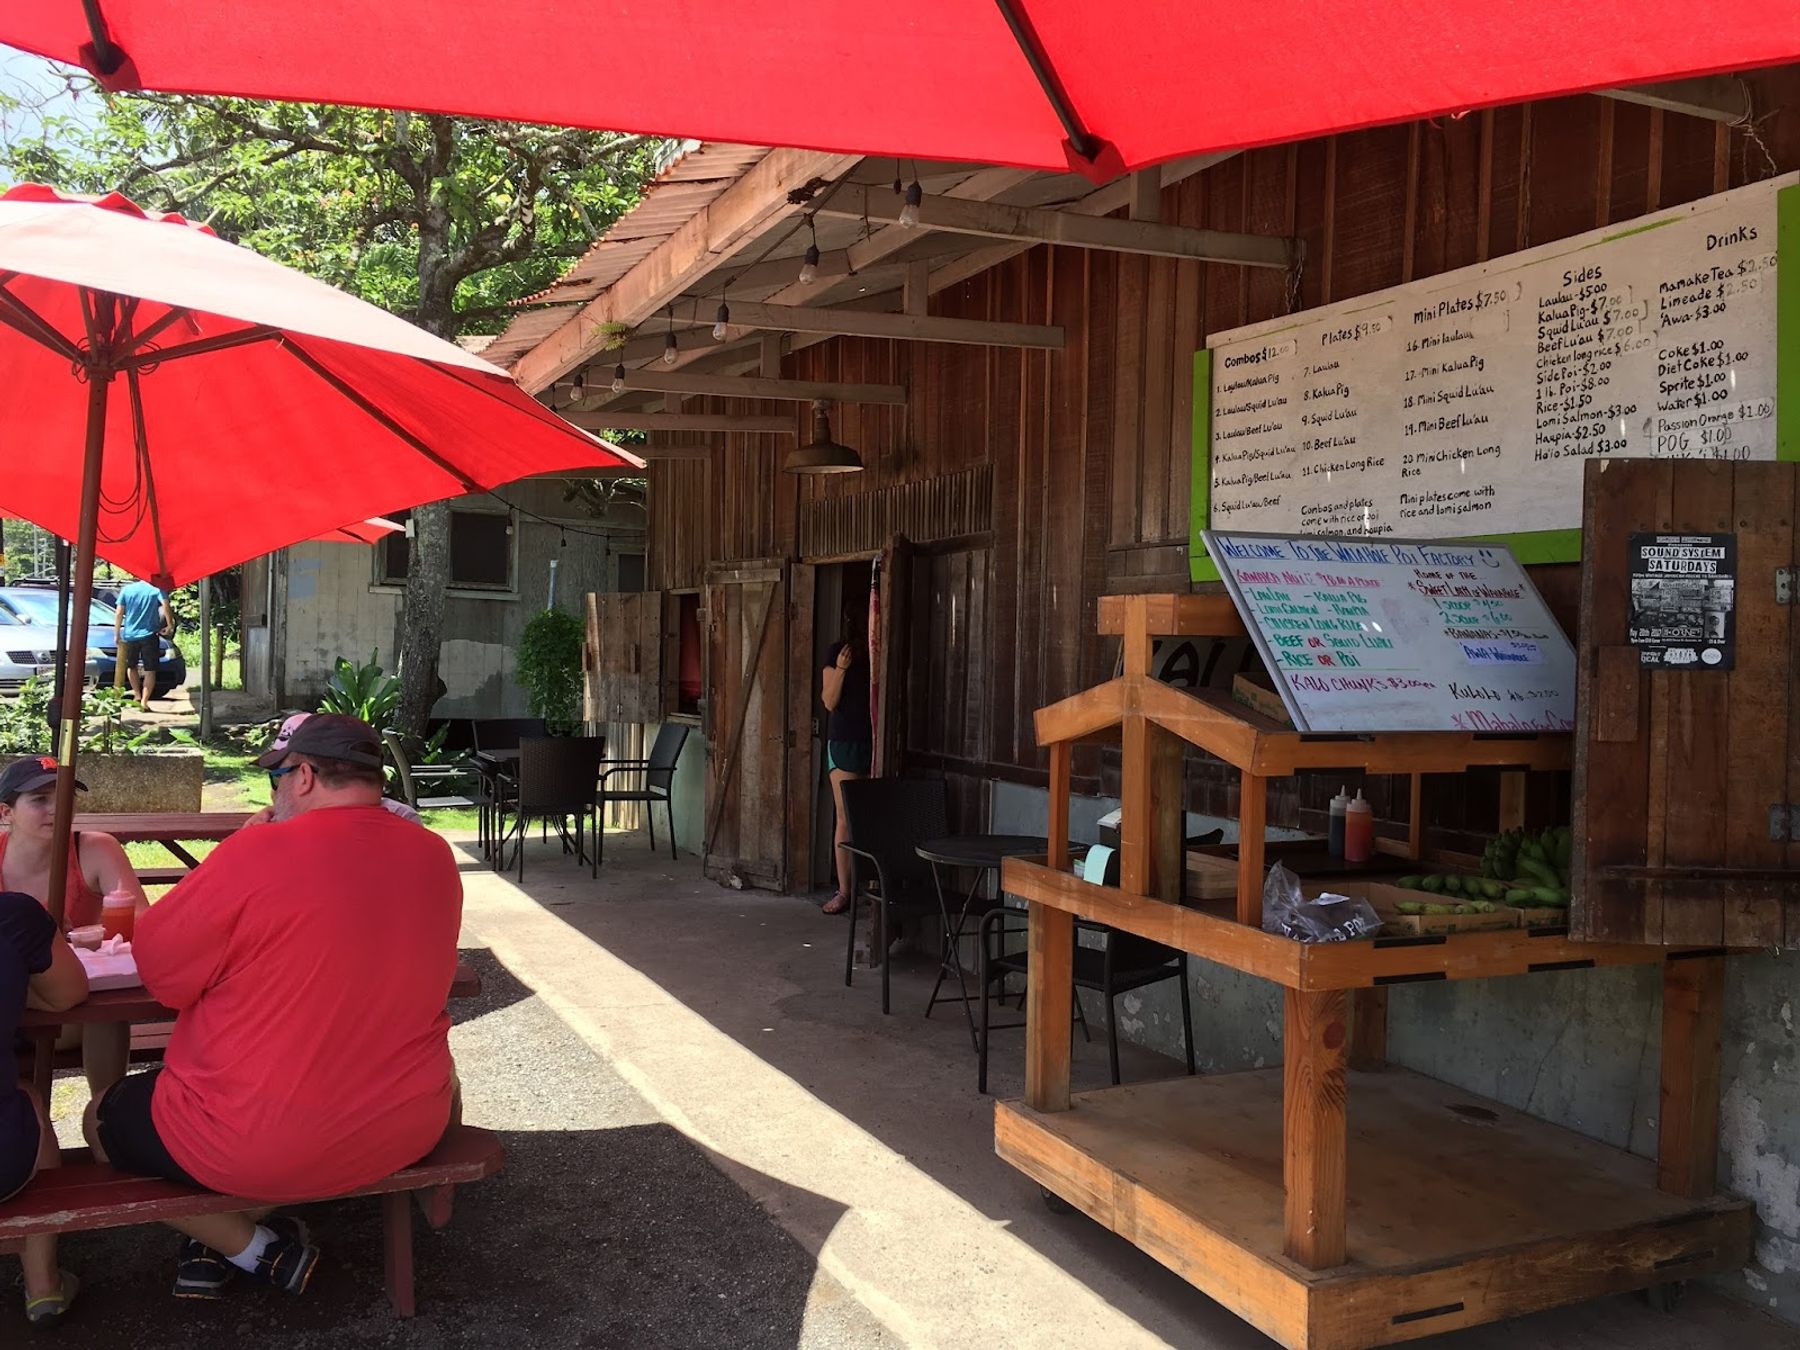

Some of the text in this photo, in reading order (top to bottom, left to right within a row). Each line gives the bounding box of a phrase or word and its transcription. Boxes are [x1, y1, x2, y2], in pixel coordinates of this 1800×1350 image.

[1563, 266, 1602, 287] Sides
[1711, 266, 1734, 281] Tea
[1438, 298, 1473, 317] Plates
[1475, 290, 1506, 311] $7.50
[1661, 288, 1712, 310] Limeade
[1538, 309, 1570, 324] Kalua
[1538, 320, 1569, 341] Squid
[1603, 308, 1639, 326] $7.00
[1322, 329, 1352, 346] Plates
[1421, 335, 1440, 349] Mini
[1538, 338, 1563, 354] Beef
[1692, 339, 1724, 356] $1.00
[1225, 352, 1260, 368] Combos
[1537, 353, 1571, 369] Chicken
[1573, 350, 1592, 362] long
[1594, 346, 1613, 356] rice
[1658, 360, 1681, 377] Diet
[1716, 351, 1749, 368] $1.00
[1421, 367, 1439, 378] Mini
[1442, 361, 1469, 373] Kalua
[1470, 355, 1485, 372] Pig
[1537, 369, 1560, 385] Side
[1660, 372, 1726, 396] Sprite $1.00
[1313, 386, 1335, 400] Kalua
[1337, 382, 1349, 398] Pig
[1417, 392, 1436, 406] Mini
[1437, 385, 1463, 404] Squid
[1657, 389, 1728, 411] Water $1.00
[1311, 410, 1332, 426] Squid
[1418, 420, 1437, 432] Mini
[1438, 414, 1461, 430] Beef
[1658, 403, 1770, 433] Passion Orange $1.00
[1314, 437, 1332, 450] Beef
[1563, 441, 1594, 457] Salad
[1597, 438, 1627, 453] $3.00
[1658, 428, 1732, 453] POG $1.00
[1222, 453, 1241, 462] Kalua
[1417, 445, 1501, 463] Mini Chicken Long
[1314, 463, 1344, 473] Chicken
[1345, 460, 1365, 472] Long
[1366, 456, 1385, 467] Rice
[1401, 468, 1421, 478] Rice
[1221, 477, 1241, 486] Kalua
[1400, 485, 1495, 506] Mini plates come with
[1222, 501, 1240, 514] Squid
[1301, 499, 1373, 515] Combos and plates
[1400, 501, 1492, 518] rice and lomi salmon
[1301, 518, 1321, 526] come
[1323, 515, 1339, 524] with
[1341, 513, 1355, 523] rice
[1216, 537, 1285, 559] WELCOME
[1642, 548, 1721, 558] SOUND SYSTEM
[1649, 560, 1717, 573] SATURDAYS
[1273, 634, 1303, 647] BEEF
[1307, 637, 1326, 648] OR
[1281, 651, 1336, 667] RICE OR
